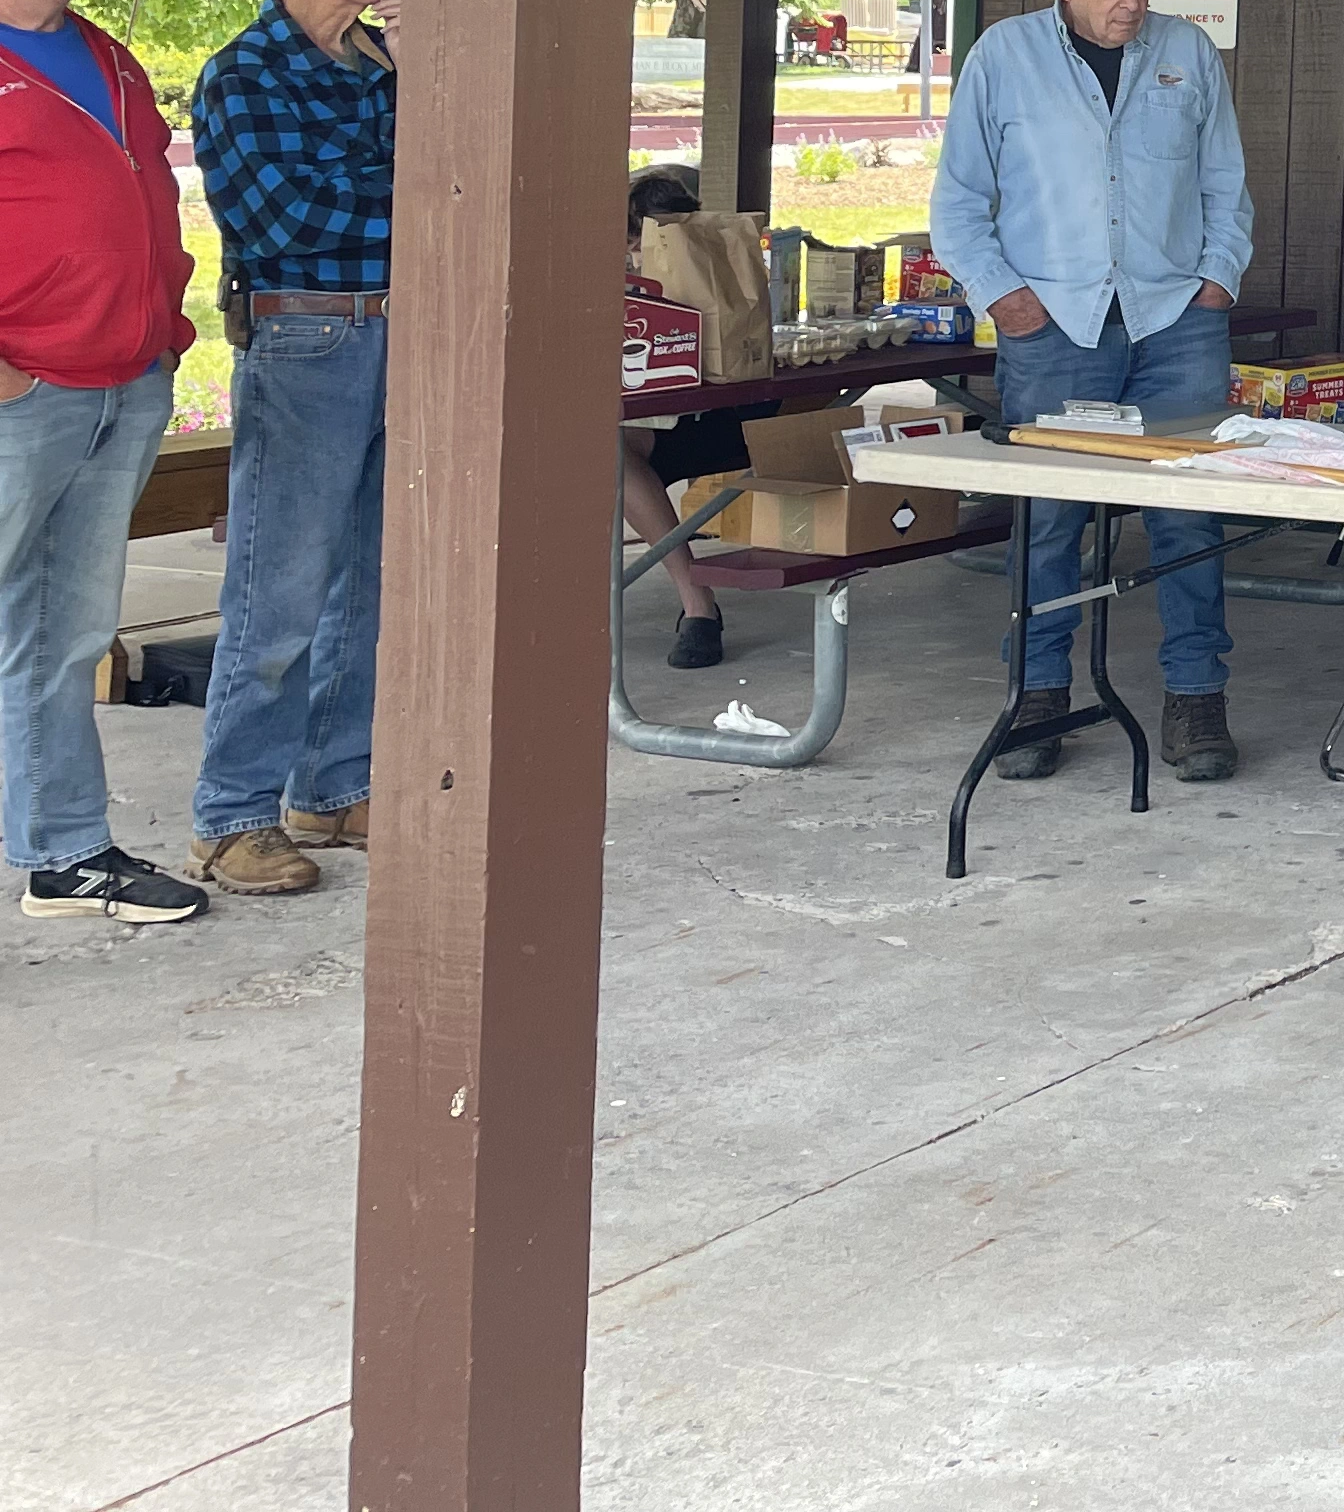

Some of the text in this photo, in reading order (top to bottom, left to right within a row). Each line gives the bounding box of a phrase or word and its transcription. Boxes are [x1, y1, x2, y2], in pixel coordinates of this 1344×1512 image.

[1185, 14, 1209, 23] NICE
[1211, 15, 1225, 24] TO
[1312, 380, 1344, 392] SUMMER
[1315, 389, 1344, 400] TREATS
